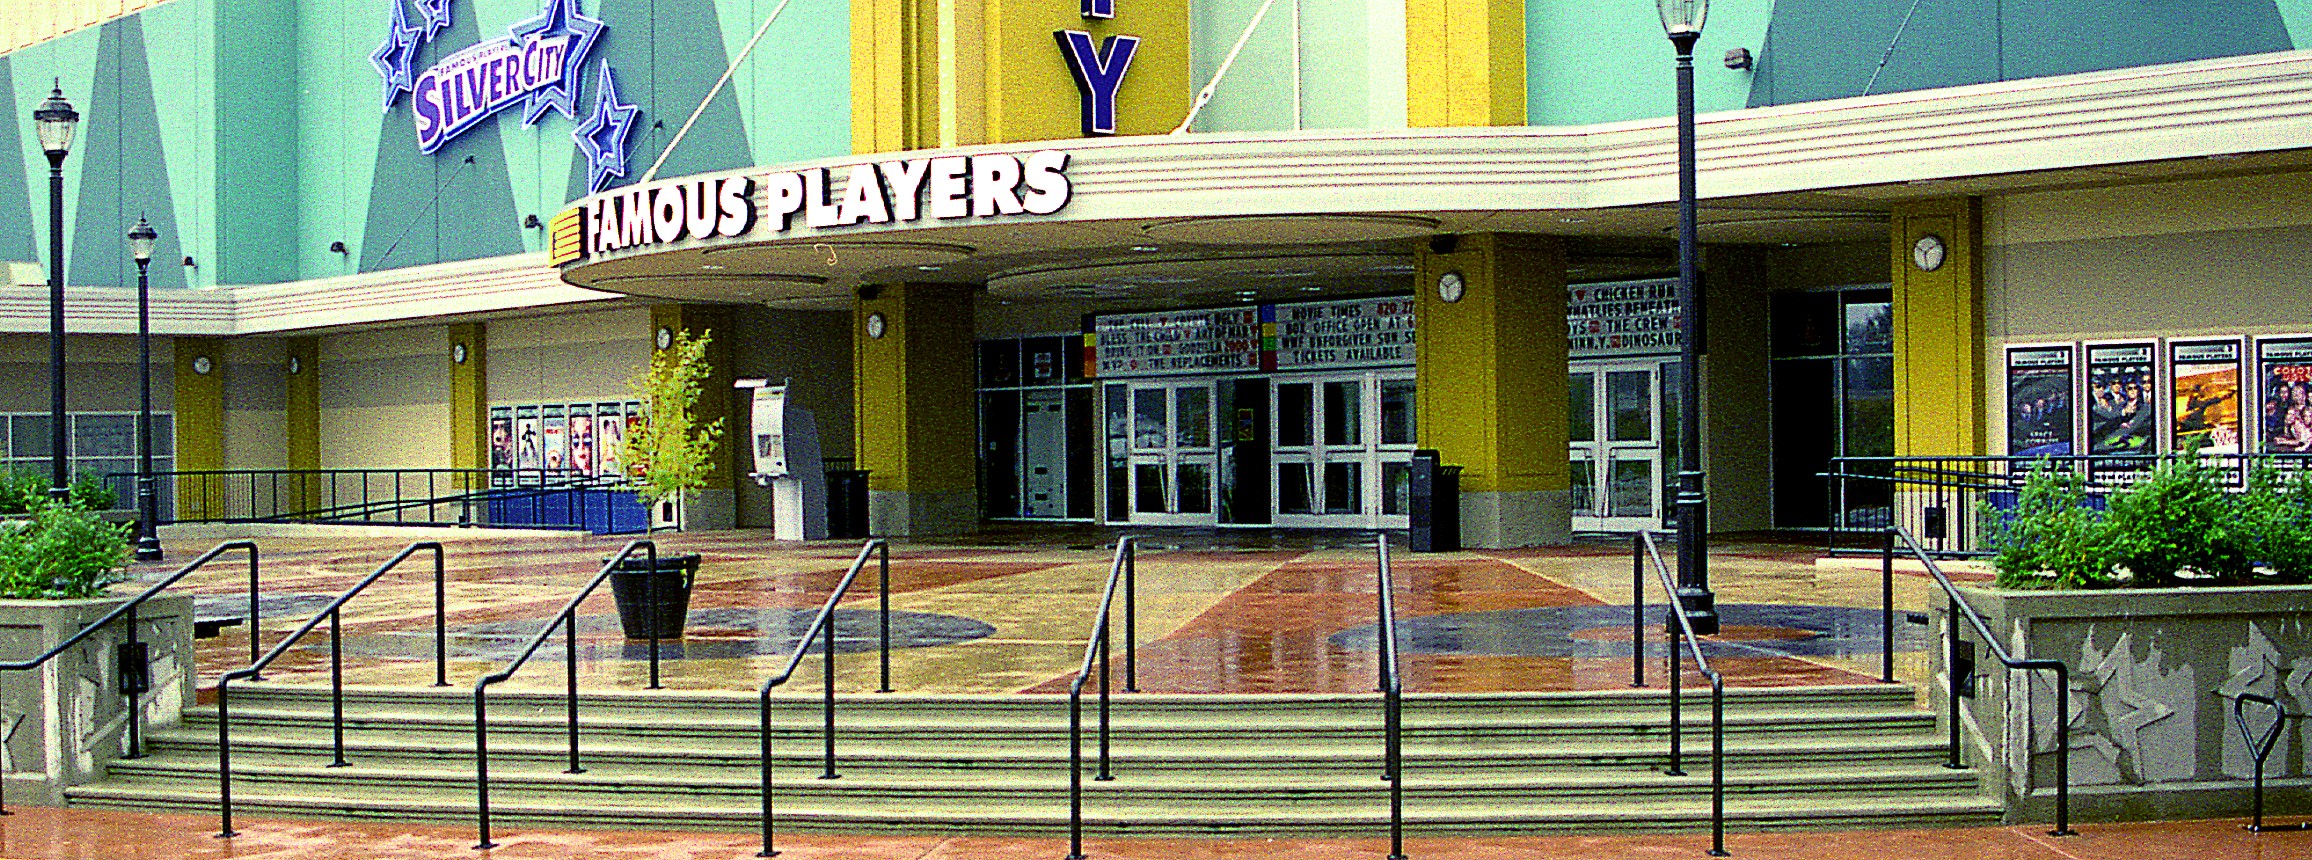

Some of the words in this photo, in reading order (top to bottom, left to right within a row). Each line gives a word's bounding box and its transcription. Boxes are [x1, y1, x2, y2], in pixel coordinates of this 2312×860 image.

[440, 53, 477, 77] FAMOUS
[587, 176, 751, 254] FAMOUS
[767, 150, 1071, 231] PLAYERS
[1594, 286, 1644, 302] CHICKEN
[1648, 284, 1675, 298] RUN
[1292, 306, 1322, 319] MOVIE
[1331, 304, 1361, 317] TIMES
[1286, 322, 1305, 335] BOX
[1314, 319, 1348, 333] OFFICE
[1353, 317, 1380, 331] OPEN
[1388, 316, 1400, 329] AT
[1606, 317, 1631, 333] THE
[1635, 315, 1668, 332] CREW
[1309, 332, 1371, 348] UNFORGIVEN
[1378, 332, 1398, 345] SUN
[1622, 331, 1681, 348] DINOSAUR
[1170, 353, 1242, 369] REPLACEMENTS
[1293, 349, 1336, 364] TICKETS
[1345, 346, 1401, 361] AVAILABLE
